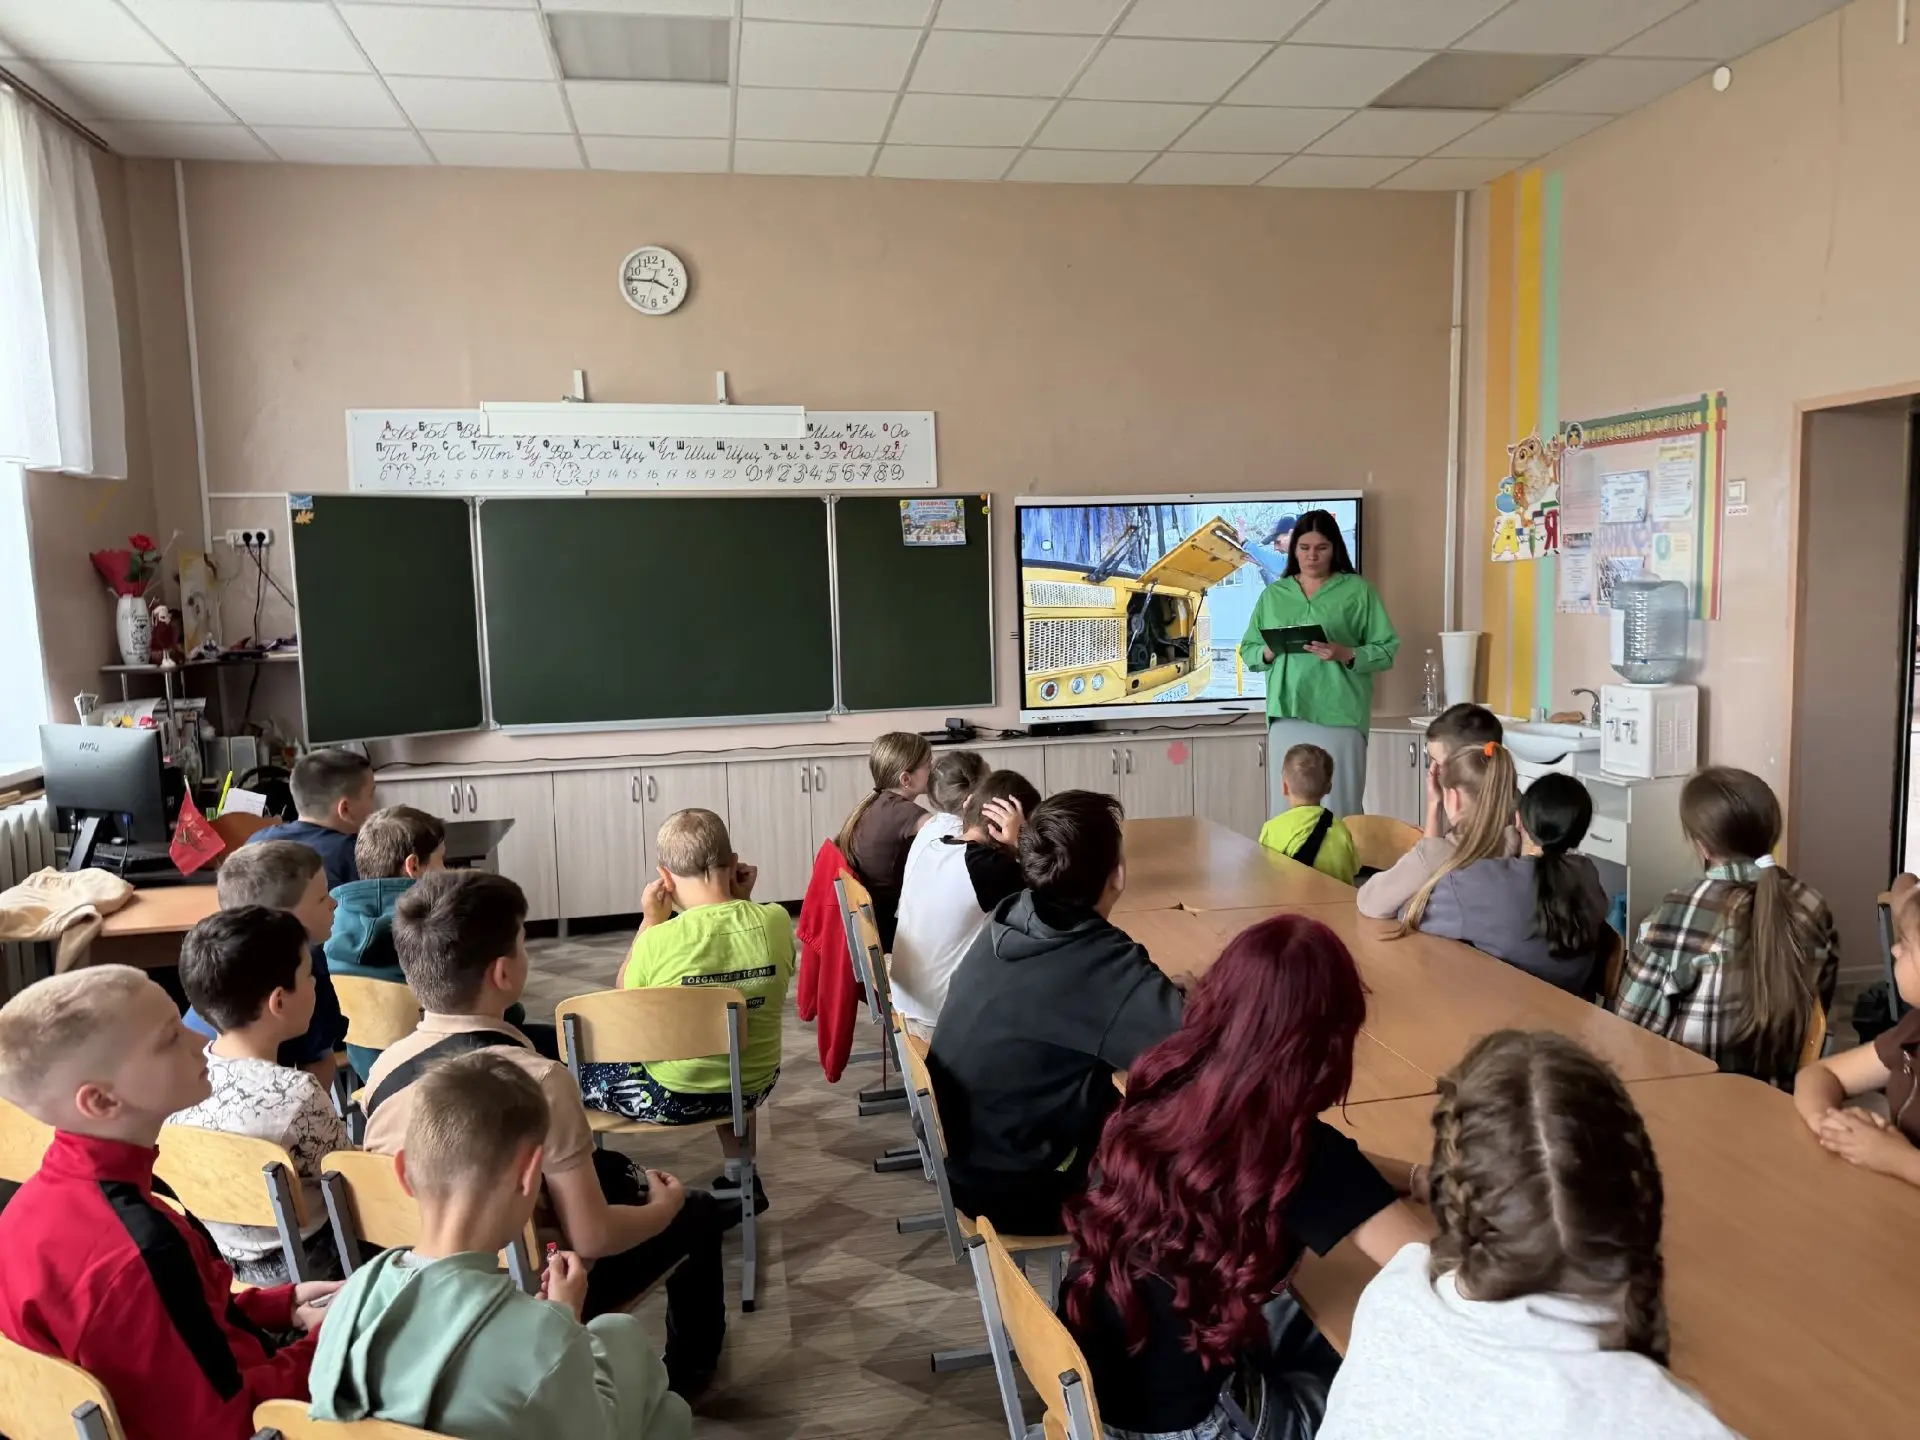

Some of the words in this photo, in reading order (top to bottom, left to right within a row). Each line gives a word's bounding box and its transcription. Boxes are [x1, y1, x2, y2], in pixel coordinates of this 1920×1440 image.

[638, 259, 647, 267] 11
[647, 256, 658, 264] 12
[660, 258, 666, 269] 1
[631, 267, 640, 275] 10
[668, 268, 674, 276] 2
[673, 277, 678, 286] 3
[632, 287, 638, 295] 8
[669, 288, 674, 296] 4
[640, 295, 645, 303] 7
[651, 299, 657, 307] 6
[662, 296, 668, 304] 5
[385, 420, 392, 430] А
[419, 422, 425, 431] Б
[457, 422, 463, 431] В
[846, 423, 852, 431] Н
[376, 443, 382, 451] П
[412, 442, 418, 451] Р
[443, 441, 449, 450] С
[471, 440, 477, 450] Т
[543, 440, 550, 448] Ф
[574, 439, 580, 449] Х
[613, 440, 620, 451] Ц
[649, 441, 655, 450] Ч
[677, 440, 684, 450] Ш
[717, 440, 725, 451] Щ
[814, 441, 820, 450] Э
[840, 441, 847, 450] Ю
[743, 967, 770, 978] TEAMS
